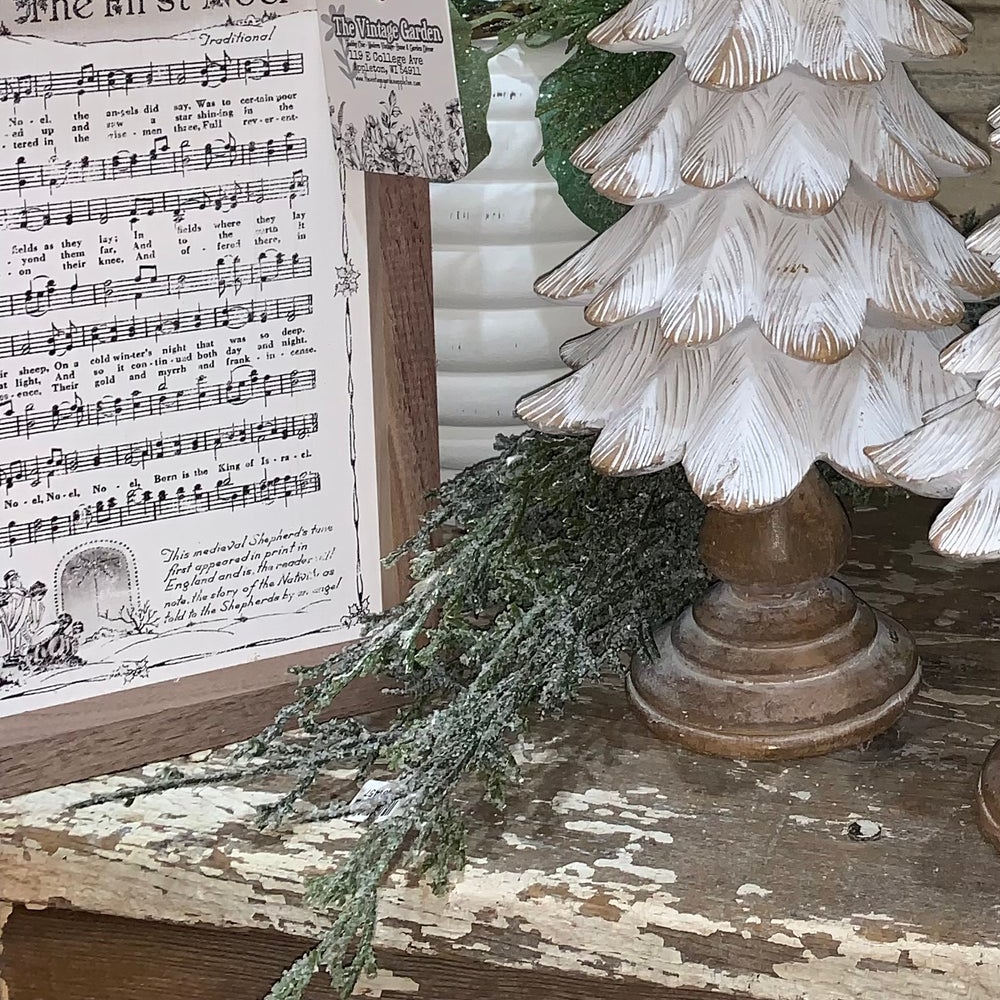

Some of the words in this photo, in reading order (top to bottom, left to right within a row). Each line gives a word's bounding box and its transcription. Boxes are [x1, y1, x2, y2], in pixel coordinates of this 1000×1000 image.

[199, 26, 275, 47] Traditional
[331, 14, 356, 38] The
[355, 15, 400, 44] Vintage
[400, 17, 443, 43] Garden
[349, 50, 363, 60] 119
[365, 51, 371, 61] E
[373, 52, 407, 66] College
[409, 54, 423, 65] Ave
[41, 128, 54, 136] up
[72, 122, 90, 132] and
[175, 113, 193, 122] star
[244, 106, 254, 115] in
[279, 102, 294, 111] the
[73, 111, 89, 121] the
[143, 104, 159, 114] did
[196, 99, 216, 108] Was
[276, 93, 297, 103] poor
[44, 137, 54, 146] in
[74, 134, 90, 143] the
[202, 120, 223, 130] Full
[44, 243, 54, 251] as
[61, 239, 83, 249] they
[134, 230, 144, 240] In
[213, 220, 242, 230] where
[256, 215, 276, 225] they
[292, 211, 306, 220] lay
[60, 250, 86, 260] them
[133, 240, 152, 250] And
[218, 231, 233, 240] the
[62, 261, 87, 271] their
[135, 250, 156, 261] And
[180, 246, 191, 255] of
[16, 376, 42, 388] light,
[55, 370, 76, 381] And
[93, 368, 105, 376] so
[117, 364, 125, 372] it
[197, 350, 218, 360] both
[225, 347, 243, 356] day
[257, 341, 274, 351] and
[281, 337, 308, 348] night.
[19, 366, 50, 376] sheep,
[54, 361, 69, 371] On
[90, 354, 111, 365] cold
[162, 343, 187, 355] night
[196, 340, 215, 350] that
[229, 336, 247, 344] was
[281, 327, 306, 337] deep.
[51, 382, 79, 392] Their
[94, 375, 116, 388] gold
[129, 371, 147, 381] and
[158, 366, 187, 377] myrrh
[198, 362, 216, 371] and
[153, 474, 178, 484] Born
[182, 470, 190, 479] is
[194, 467, 209, 477] the
[218, 463, 241, 473] King
[245, 458, 254, 468] of
[160, 546, 190, 563] This
[193, 535, 248, 557] medieval
[248, 526, 308, 547] Shepherd's
[311, 524, 333, 535] tune
[163, 562, 193, 583] first
[194, 550, 251, 575] appeared
[251, 551, 261, 561] in
[260, 541, 296, 565] print
[298, 542, 308, 551] in
[165, 571, 218, 592] England
[218, 565, 243, 581] and
[257, 560, 274, 573] the
[192, 588, 208, 603] the
[210, 586, 239, 598] story
[242, 579, 260, 598] of
[258, 575, 275, 589] the
[322, 569, 335, 577] as
[163, 608, 187, 624] told
[188, 608, 197, 619] to
[200, 602, 216, 616] the
[220, 592, 280, 613] Shepherds
[282, 588, 295, 602] by
